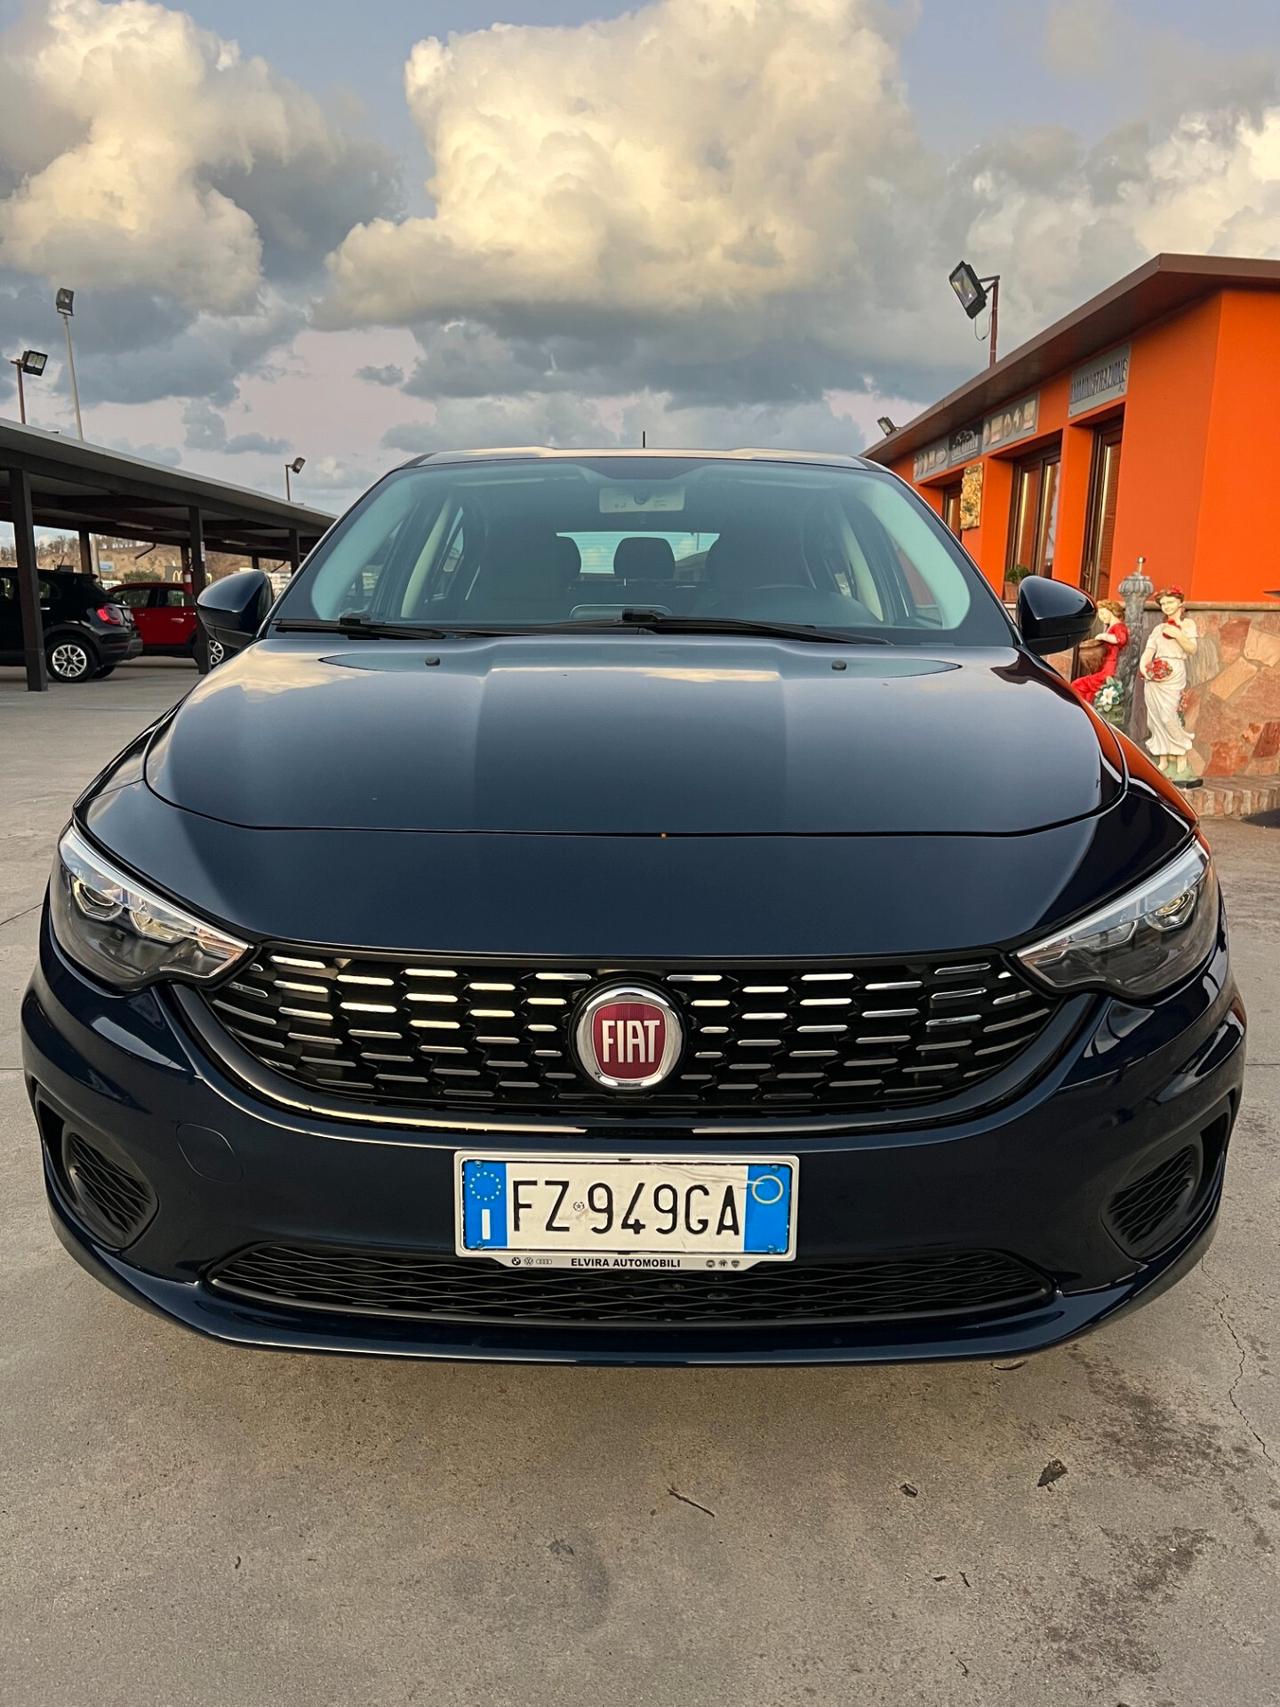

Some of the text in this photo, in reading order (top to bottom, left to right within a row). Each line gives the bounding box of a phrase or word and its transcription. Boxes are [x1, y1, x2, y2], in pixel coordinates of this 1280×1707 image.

[602, 1020, 660, 1063] FIAT
[481, 1208, 491, 1240] I
[571, 1257, 681, 1268] ELVIRA AUTOMOBILI
